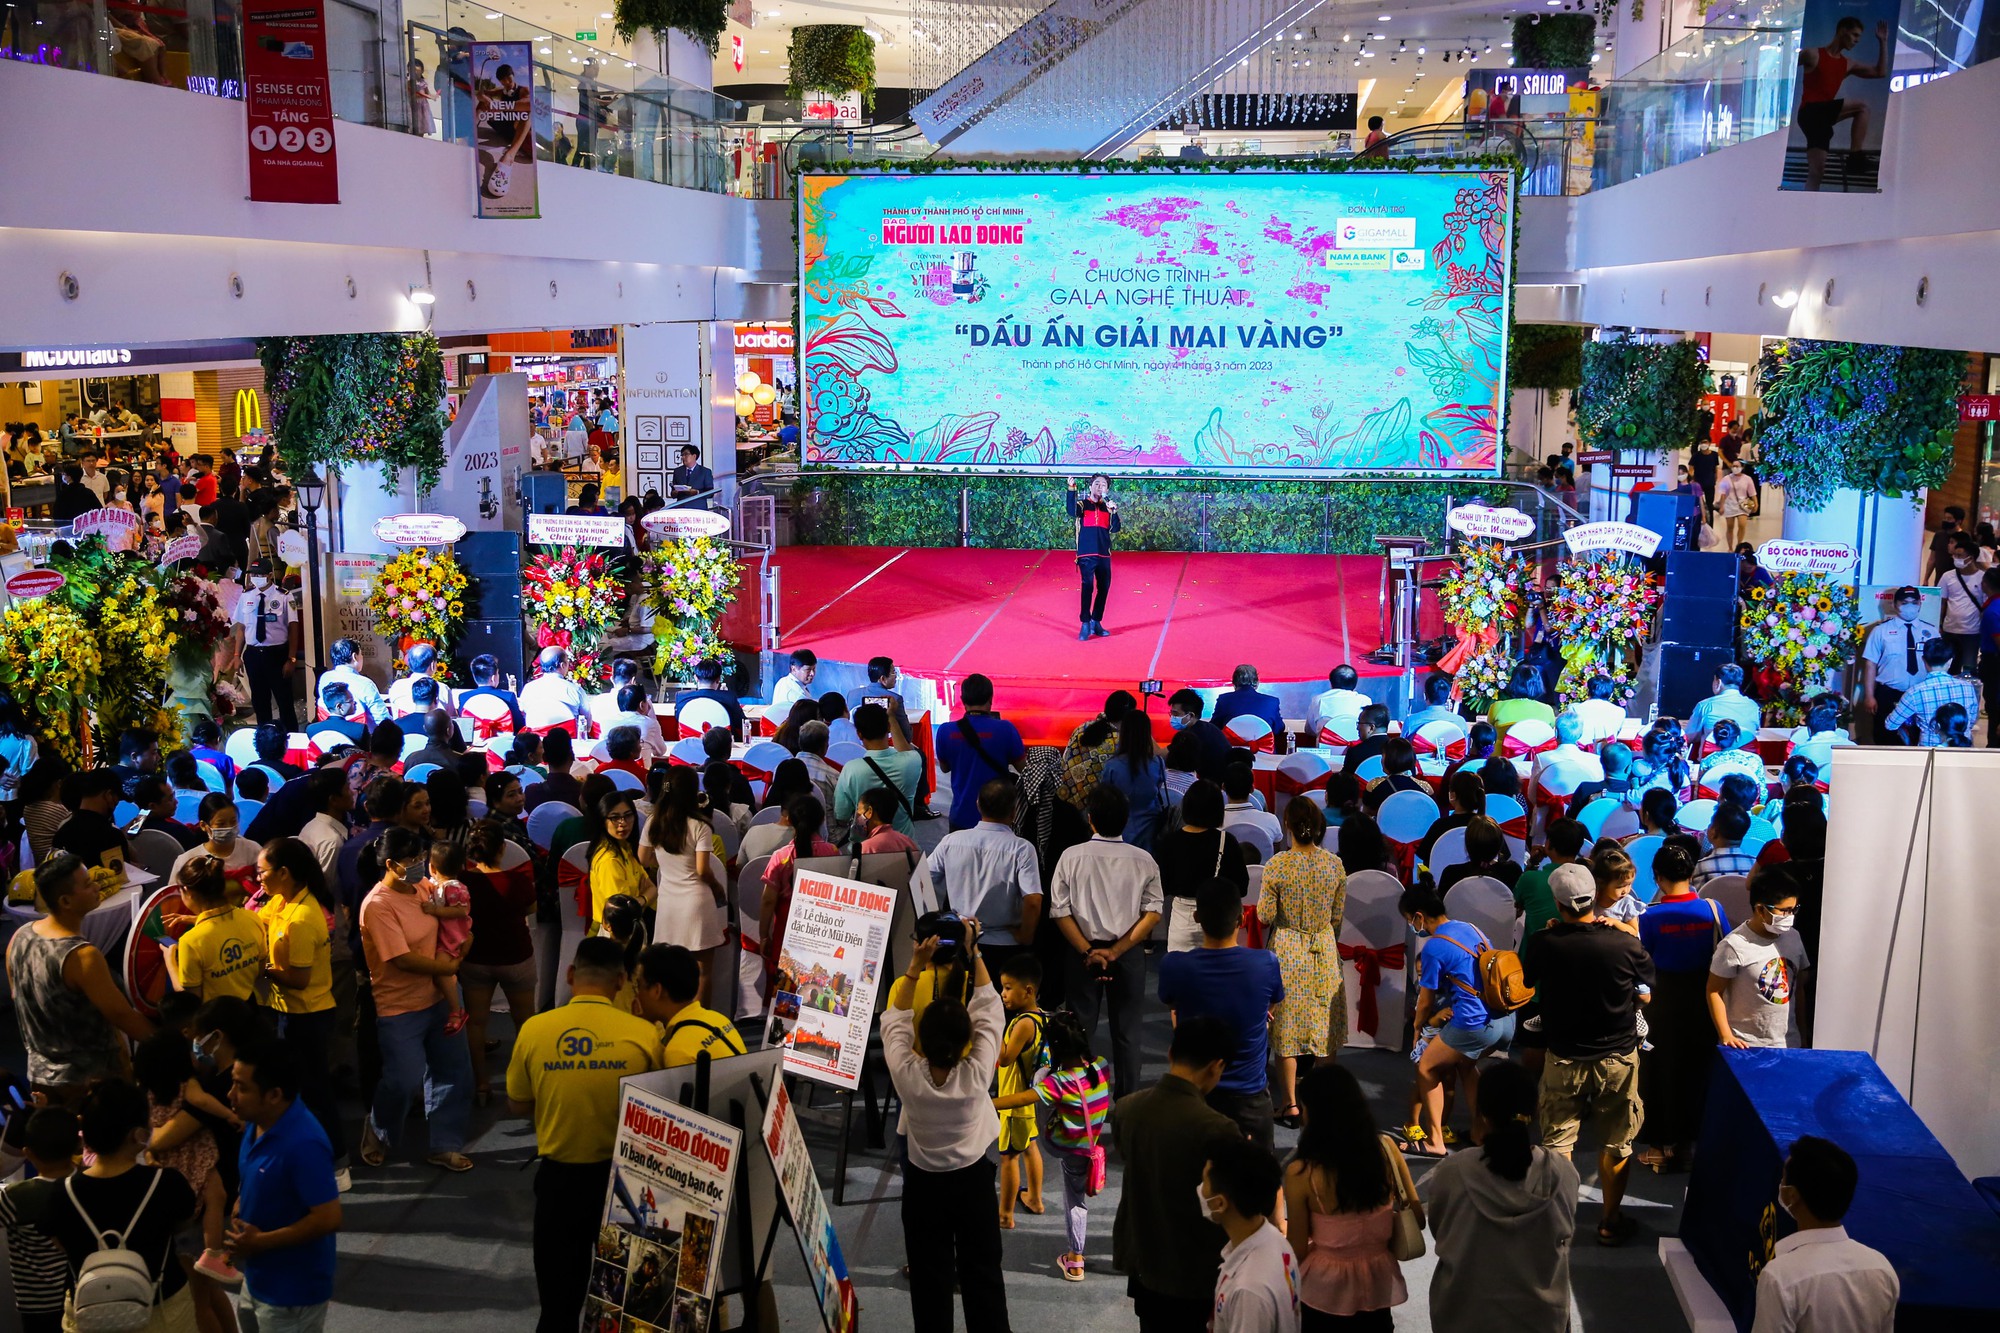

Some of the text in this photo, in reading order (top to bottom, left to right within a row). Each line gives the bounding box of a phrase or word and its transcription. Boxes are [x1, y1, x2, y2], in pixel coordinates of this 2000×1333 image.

[255, 83, 294, 94] SENSE
[296, 84, 321, 96] CITY
[1523, 74, 1565, 95] SAILOR
[490, 101, 516, 110] NEW
[478, 112, 529, 122] OPENING
[258, 130, 325, 148] 1 2 3
[940, 225, 972, 244] LAO
[1358, 228, 1408, 238] GIGAMALL
[1084, 267, 1210, 283] CHƯƠNG TRÌNH
[1050, 286, 1246, 310] GALA NGHỆ THUẬT
[734, 330, 794, 348] uardia
[1042, 314, 1084, 348] ẤN
[1094, 316, 1158, 348] GIẢI
[1170, 326, 1226, 348] MAI
[1022, 359, 1052, 370] Thành
[1054, 358, 1075, 371] phố
[1078, 358, 1092, 370] Hồ
[1094, 359, 1112, 370] Chí
[1144, 360, 1169, 372] ngày
[1181, 360, 1212, 372] tháng
[1214, 361, 1220, 370] 3
[1223, 360, 1247, 370] năm
[1250, 361, 1273, 371] 2023
[626, 388, 698, 399] INFORMATION
[1720, 402, 1730, 434] SALE
[464, 451, 499, 472] 2023
[74, 510, 98, 534] NAM
[108, 510, 135, 528] BANK
[1512, 518, 1528, 527] MINH
[1768, 546, 1849, 559] BỘ CÔNG THƯƠNG
[834, 886, 858, 906] LAO
[814, 911, 833, 926] chào
[806, 922, 820, 938] biệt
[224, 944, 242, 964] 30
[211, 966, 234, 978] NAM
[242, 956, 259, 968] BAN
[563, 1036, 614, 1056] 30 years
[544, 1060, 628, 1072] NAM A BANK
[624, 1102, 667, 1142] Người
[666, 1118, 691, 1152] lao
[628, 1146, 646, 1168] bạn
[665, 1163, 688, 1188] cùng
[688, 1171, 706, 1195] bạn
[706, 1180, 724, 1204] đọc
